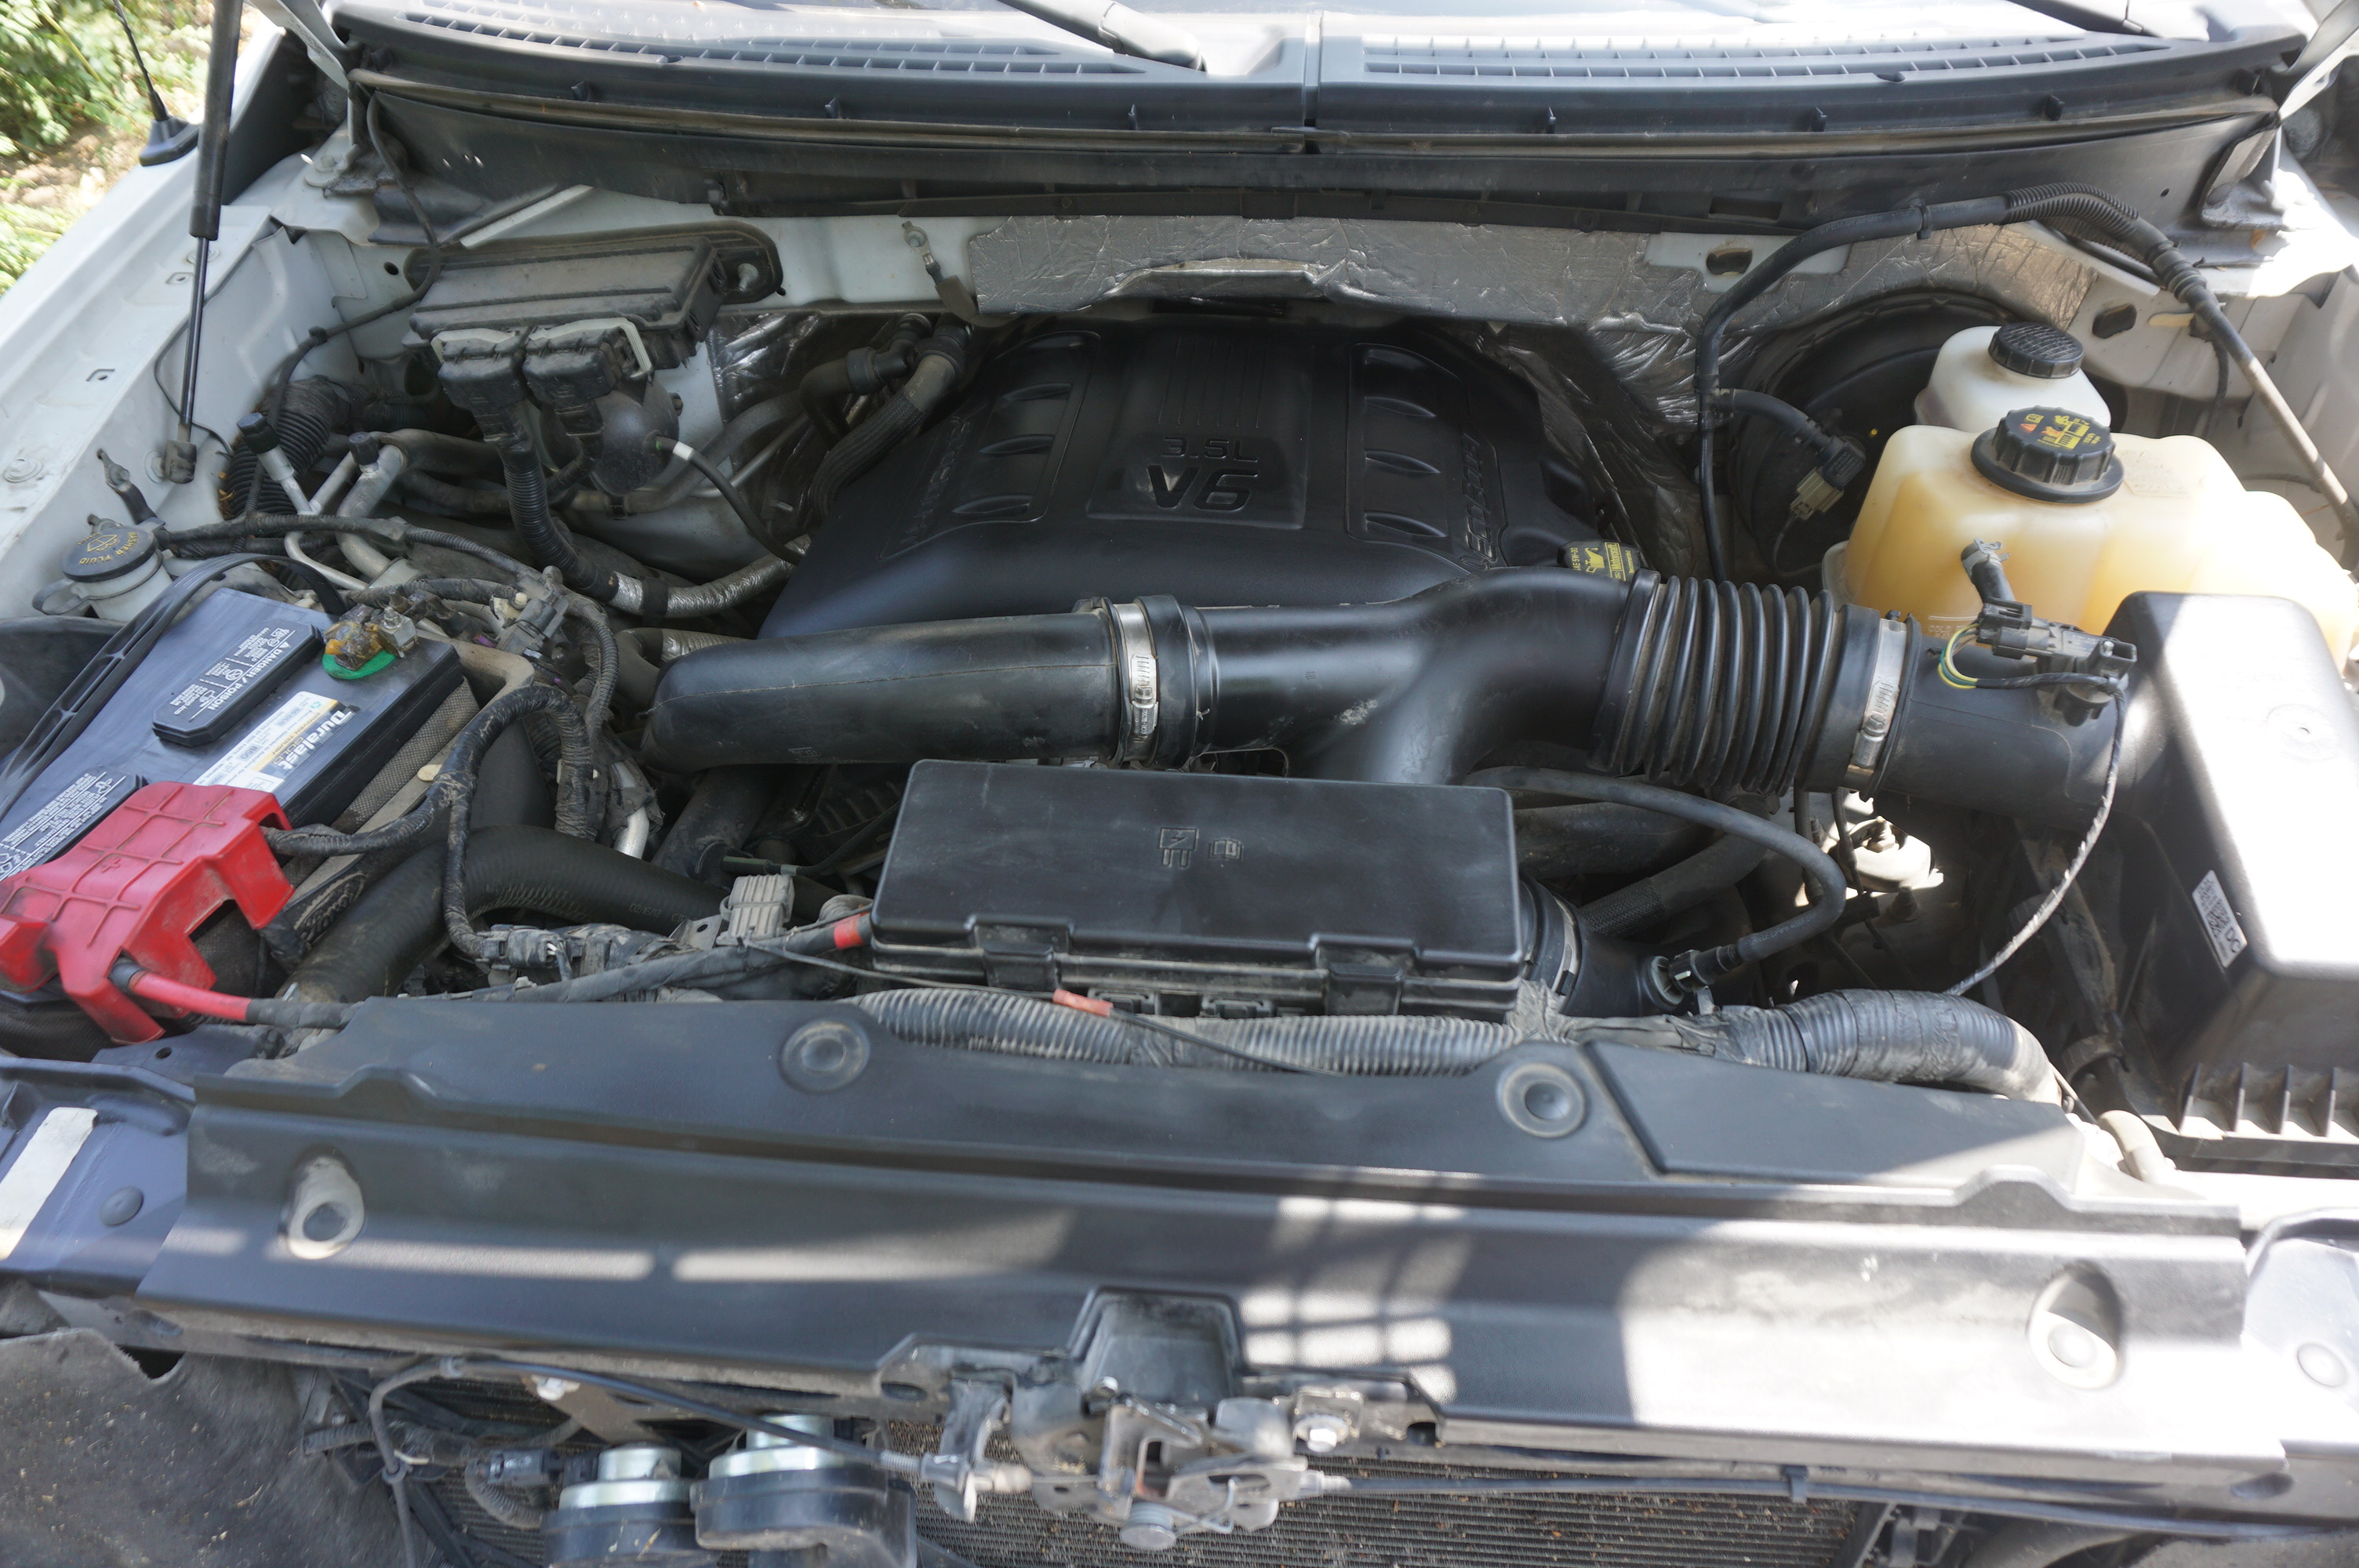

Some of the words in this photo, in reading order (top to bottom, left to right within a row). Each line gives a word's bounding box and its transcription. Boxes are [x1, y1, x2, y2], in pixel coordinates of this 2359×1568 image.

[1161, 437, 1258, 463] 3.5L
[1147, 464, 1259, 512] V6
[114, 532, 138, 556] WASHER
[1608, 543, 1622, 570] Motorcraft
[79, 554, 112, 564] FLUID
[246, 649, 283, 678] DANGER
[207, 682, 242, 710] POISON
[274, 737, 304, 764] GOLD
[278, 709, 353, 770] Duralast
